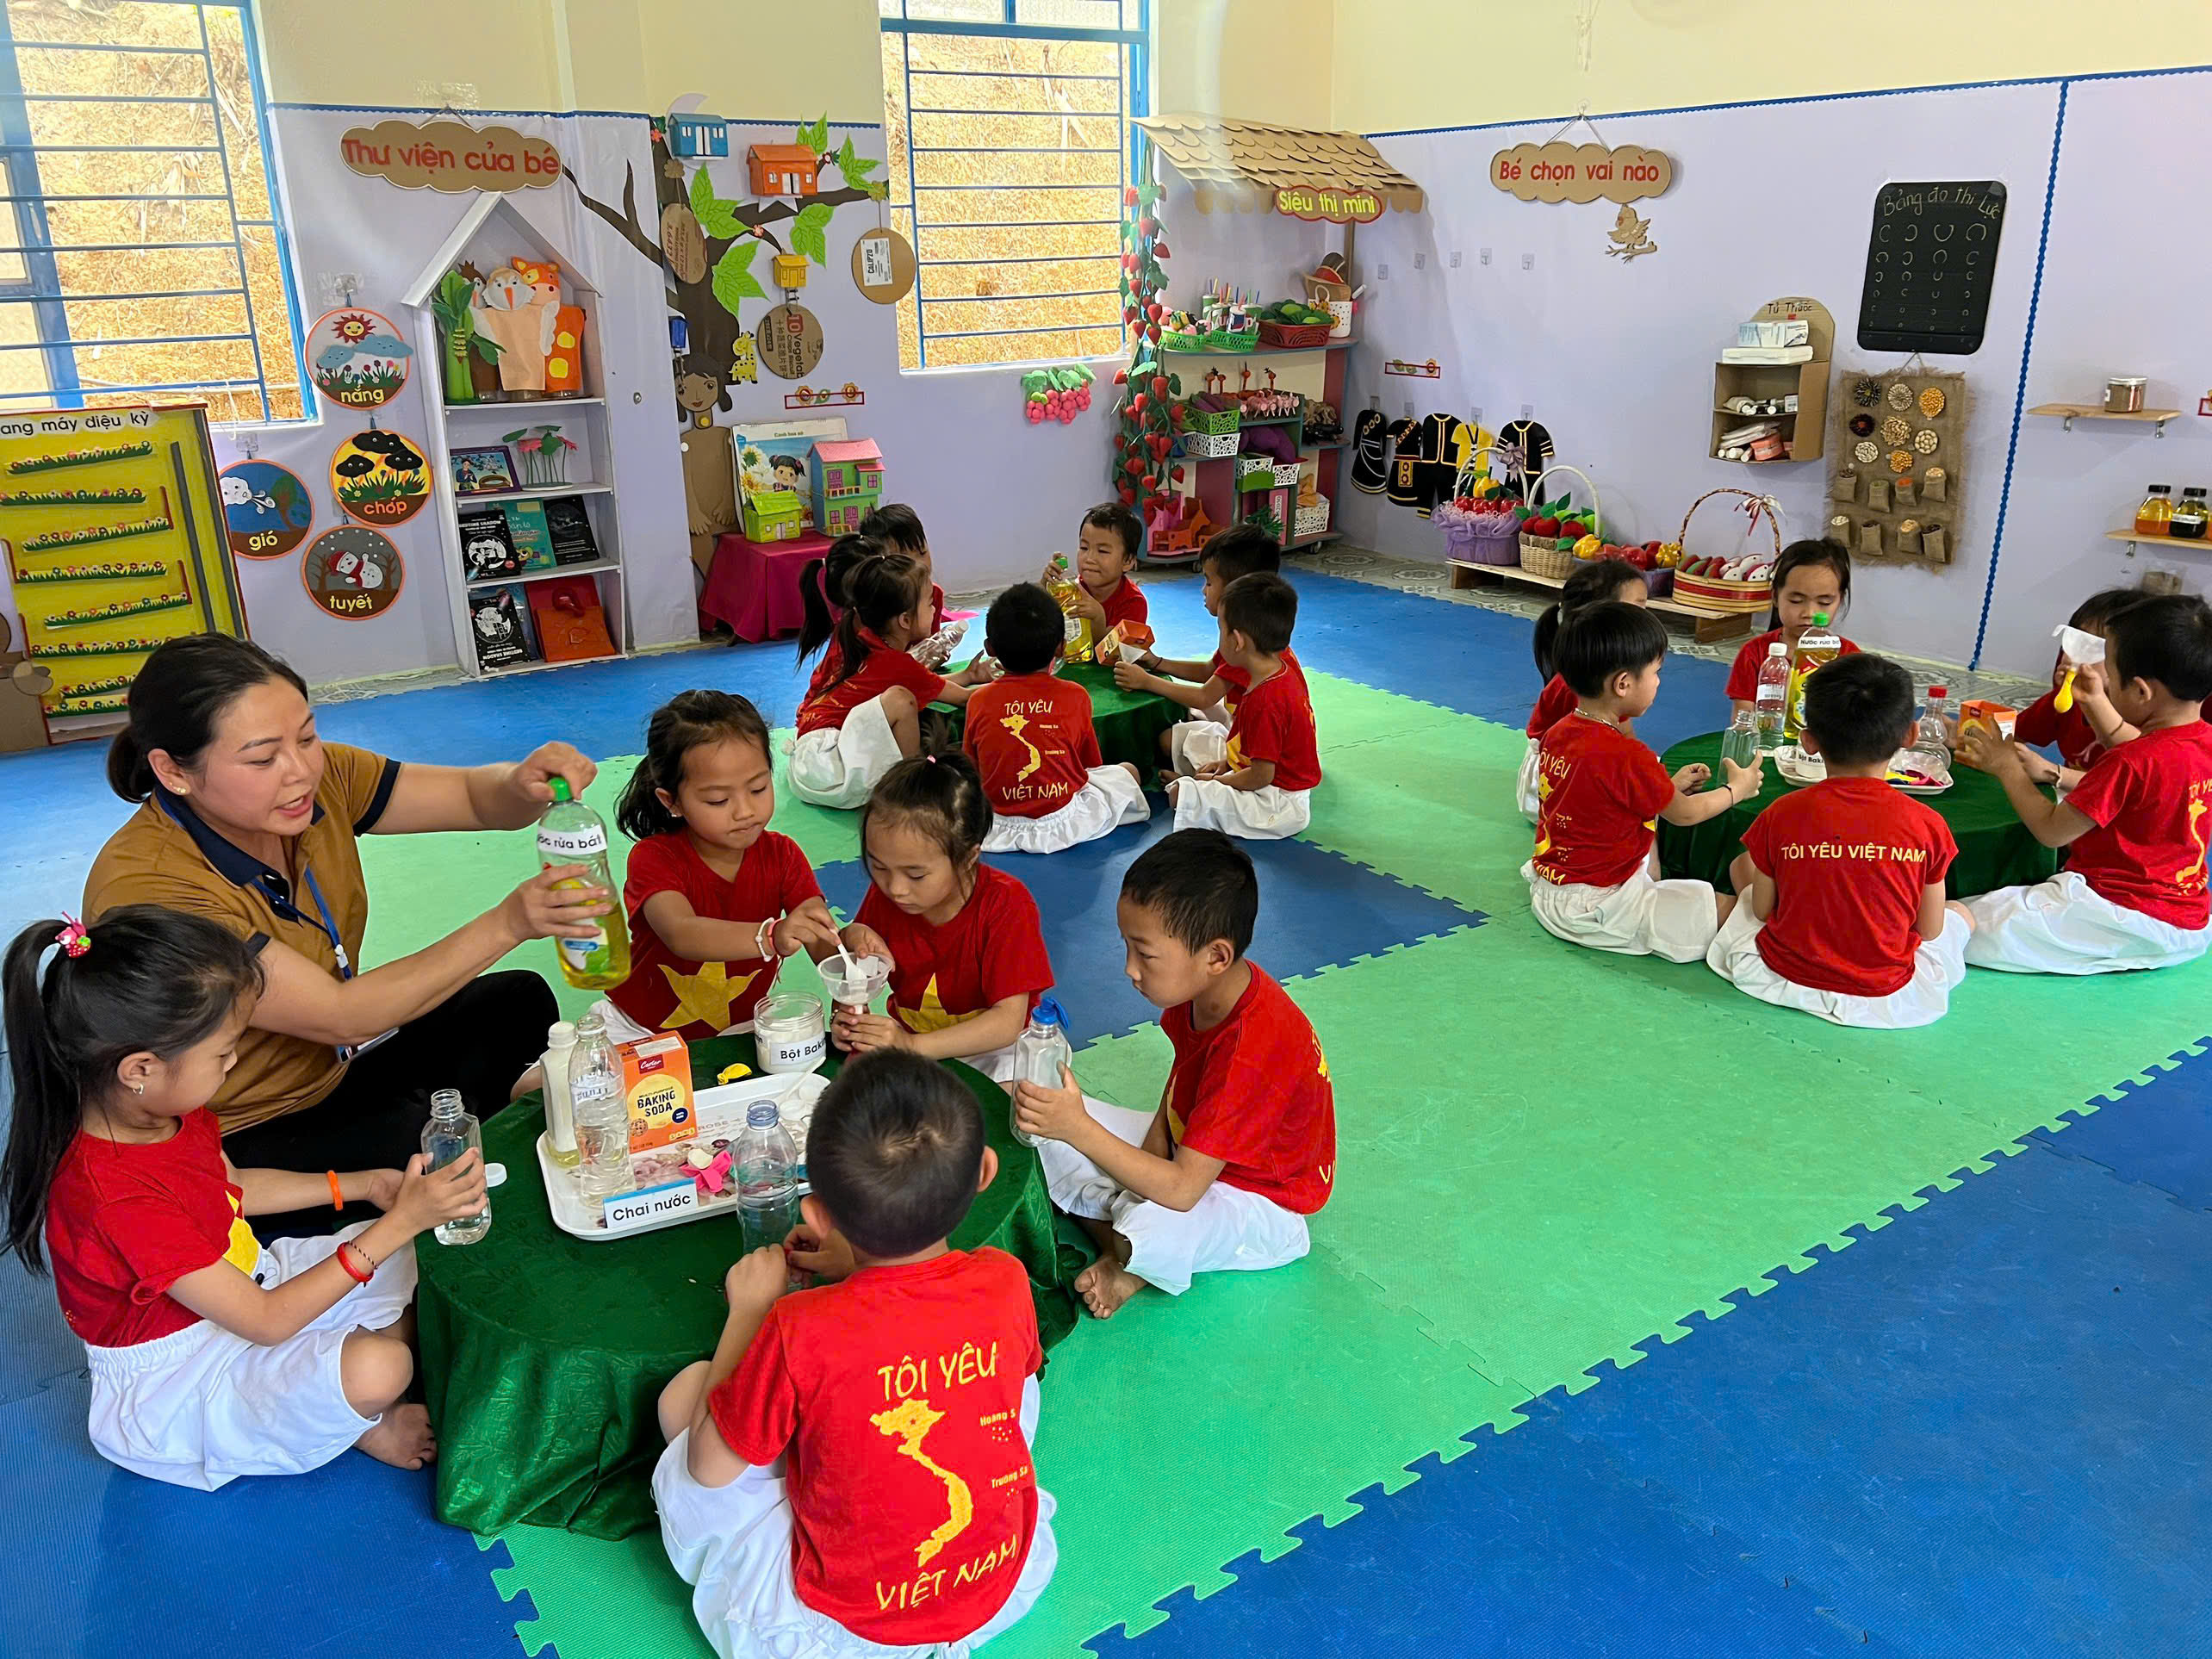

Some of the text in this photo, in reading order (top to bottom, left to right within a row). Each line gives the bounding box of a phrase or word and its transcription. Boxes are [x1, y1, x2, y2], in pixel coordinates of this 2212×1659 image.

[342, 138, 559, 174] Thư viện của bé
[1499, 155, 1660, 187] Bé chọn vai nào
[1278, 190, 1376, 217] Siêu thị mini
[1882, 188, 1923, 216] Bảng
[788, 315, 800, 332] 10
[340, 384, 385, 404] nắng
[41, 416, 78, 432] máy
[85, 415, 121, 430] diệu
[130, 411, 149, 426] kỳ
[363, 496, 407, 515] chớp
[248, 530, 278, 551] gió
[330, 593, 373, 612] tuyết
[1004, 699, 1053, 716] TÔI YÊU
[1002, 781, 1068, 801] VIỆT NAM
[578, 833, 602, 848] bát
[1781, 842, 1927, 862] TÔI YÊU VIỆT NAM
[780, 1049, 801, 1061] Bột
[637, 1090, 675, 1109] BAKING
[644, 1102, 673, 1117] SODA
[612, 1194, 691, 1221] Chai nước
[878, 1341, 997, 1401] TÔI YÊU
[876, 1533, 1018, 1610] VIỆT NAM
